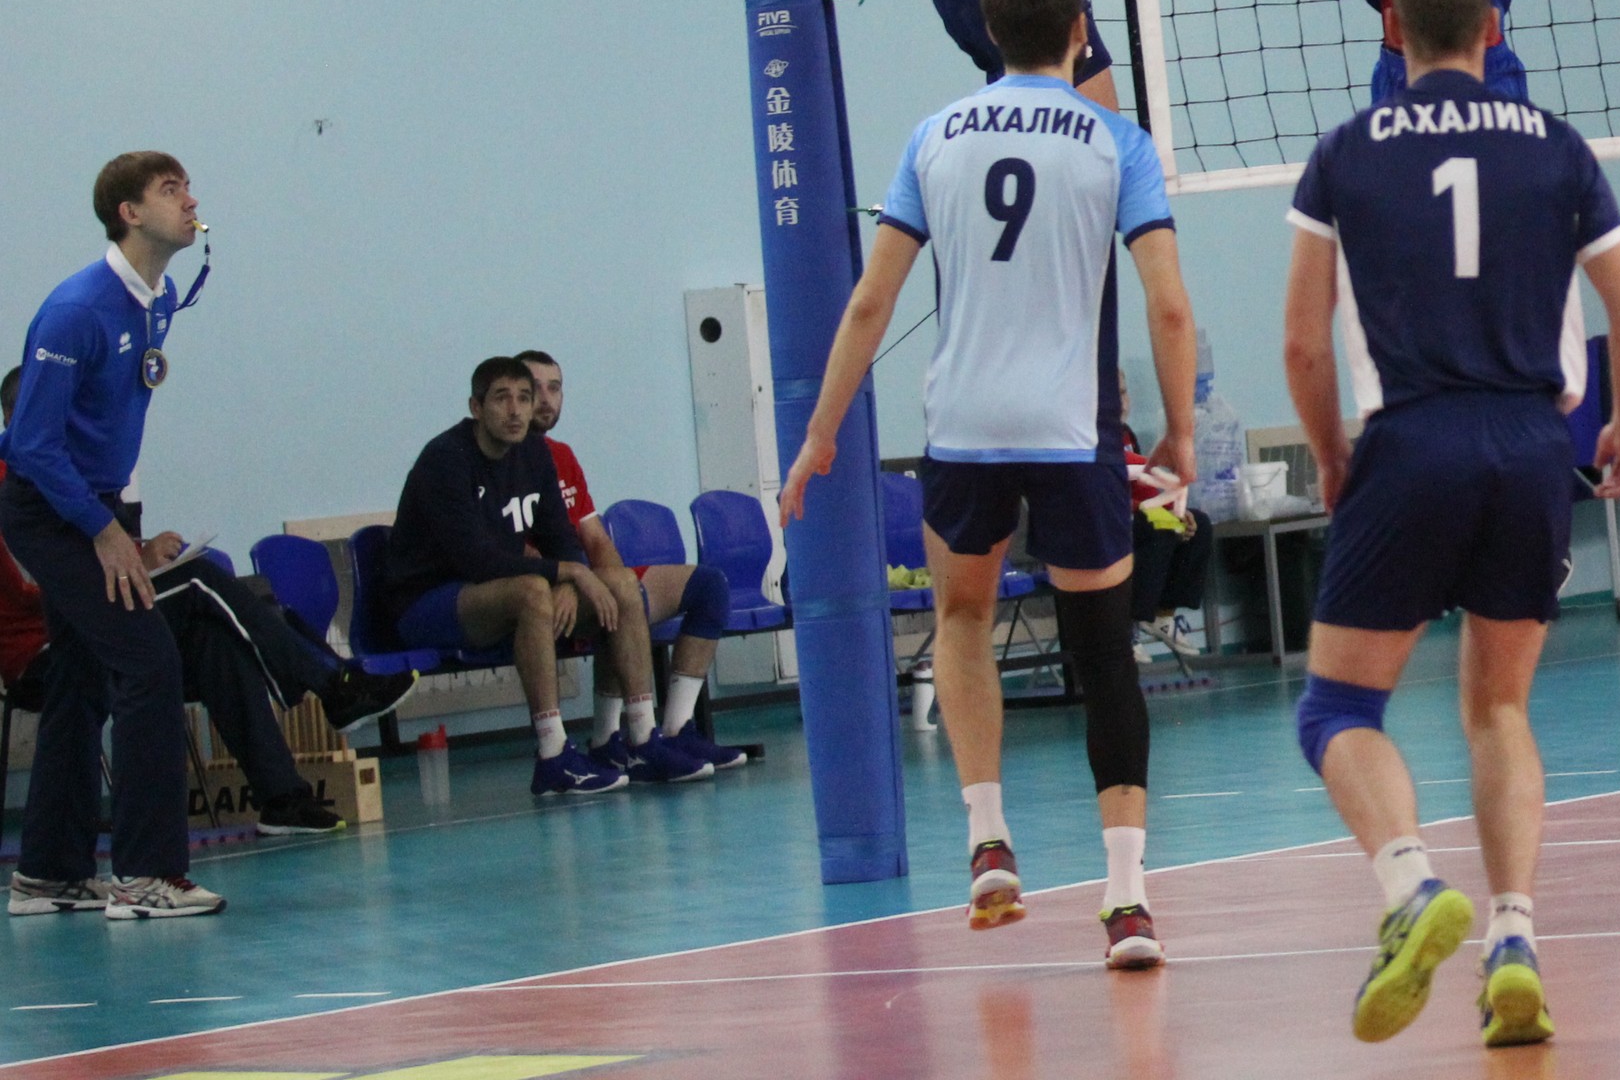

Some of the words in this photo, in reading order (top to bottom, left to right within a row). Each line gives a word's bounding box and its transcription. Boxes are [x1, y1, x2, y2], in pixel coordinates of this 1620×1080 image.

[766, 87, 800, 226] 金陵体育
[945, 106, 1097, 145] САХАЛИН
[1369, 100, 1548, 142] САХАЛИН
[985, 157, 1036, 262] 9
[1432, 157, 1480, 278] 1
